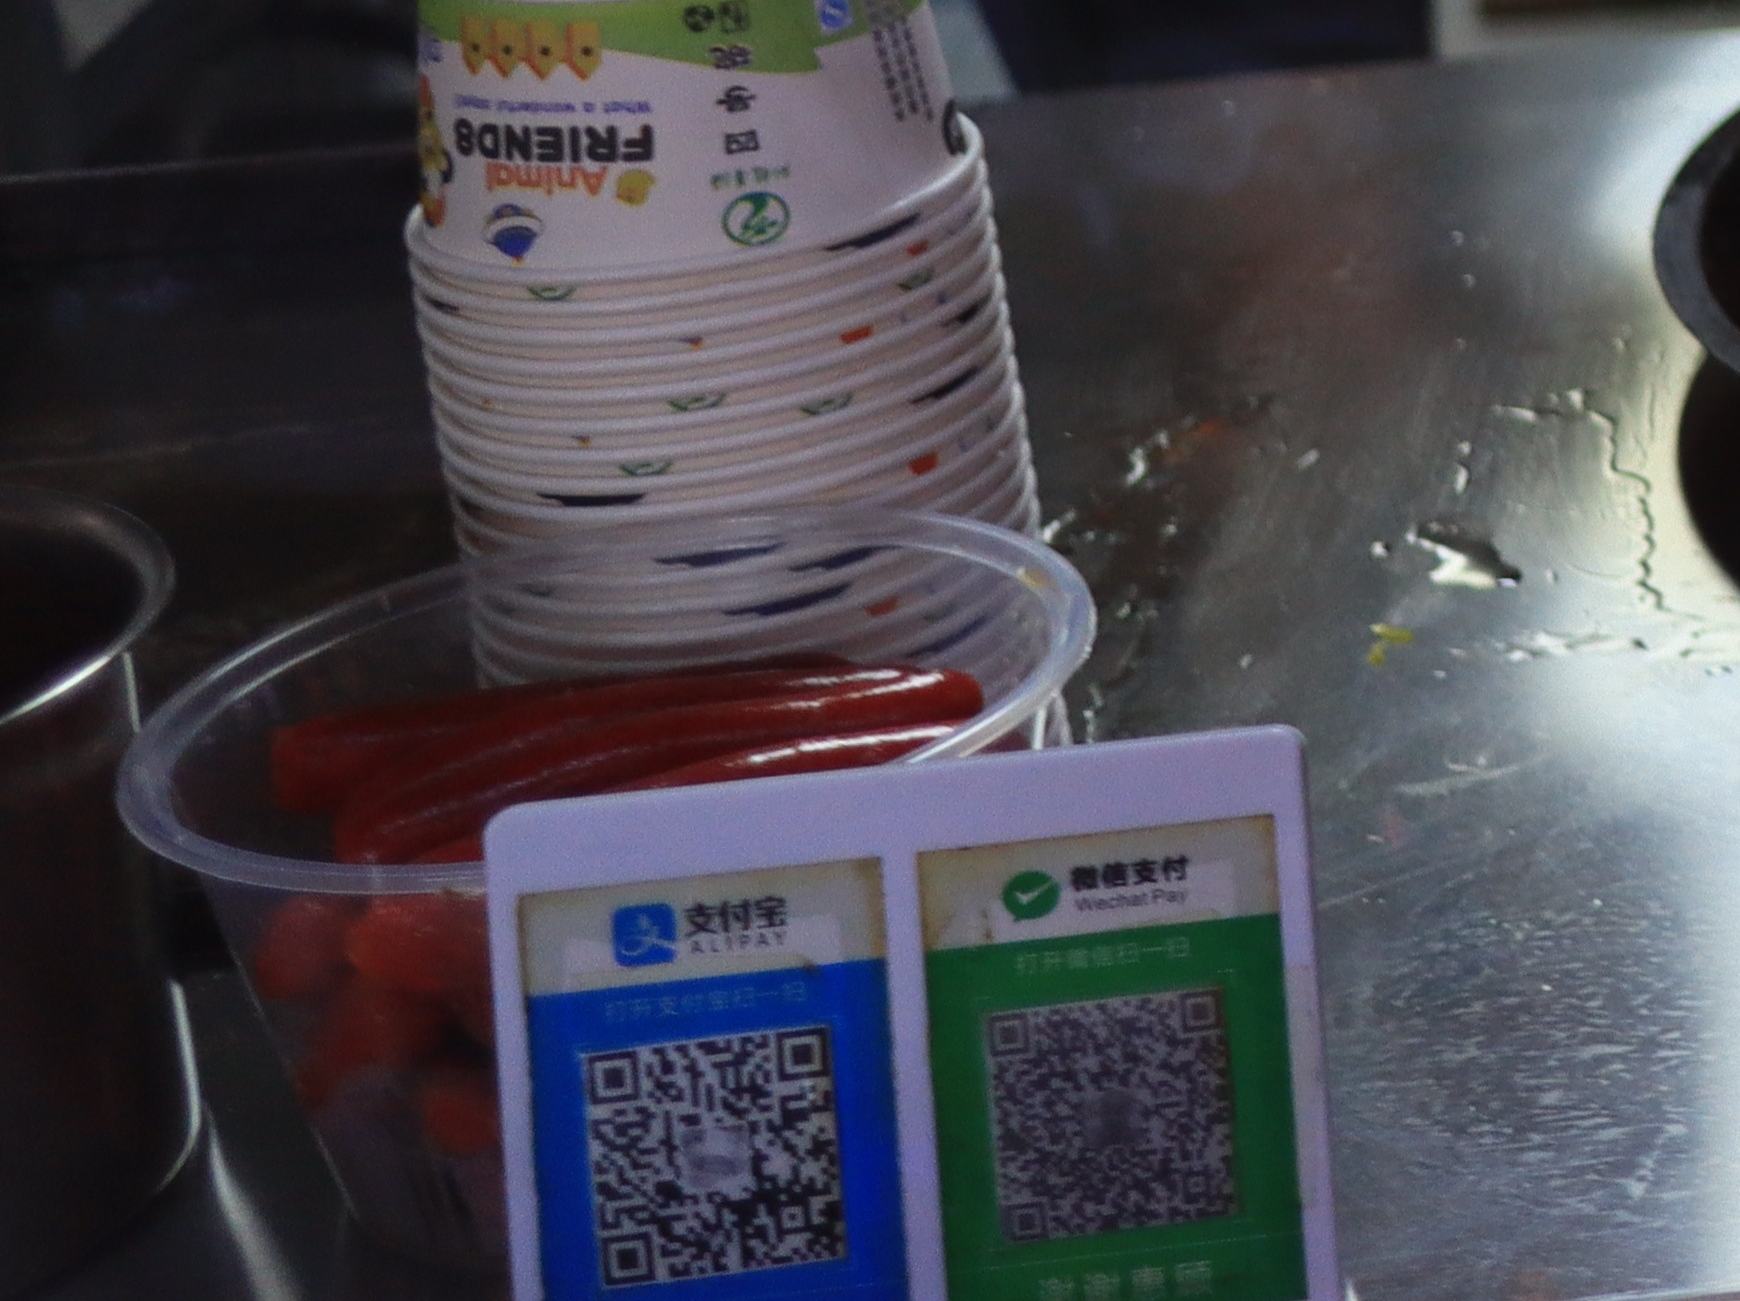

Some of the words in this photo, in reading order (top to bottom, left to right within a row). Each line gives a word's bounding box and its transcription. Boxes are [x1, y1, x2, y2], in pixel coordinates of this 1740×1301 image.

[486, 156, 608, 197] Animal
[1071, 854, 1188, 892] 微信支付
[684, 895, 788, 939] 支付宝
[690, 930, 788, 954] ALIPAY
